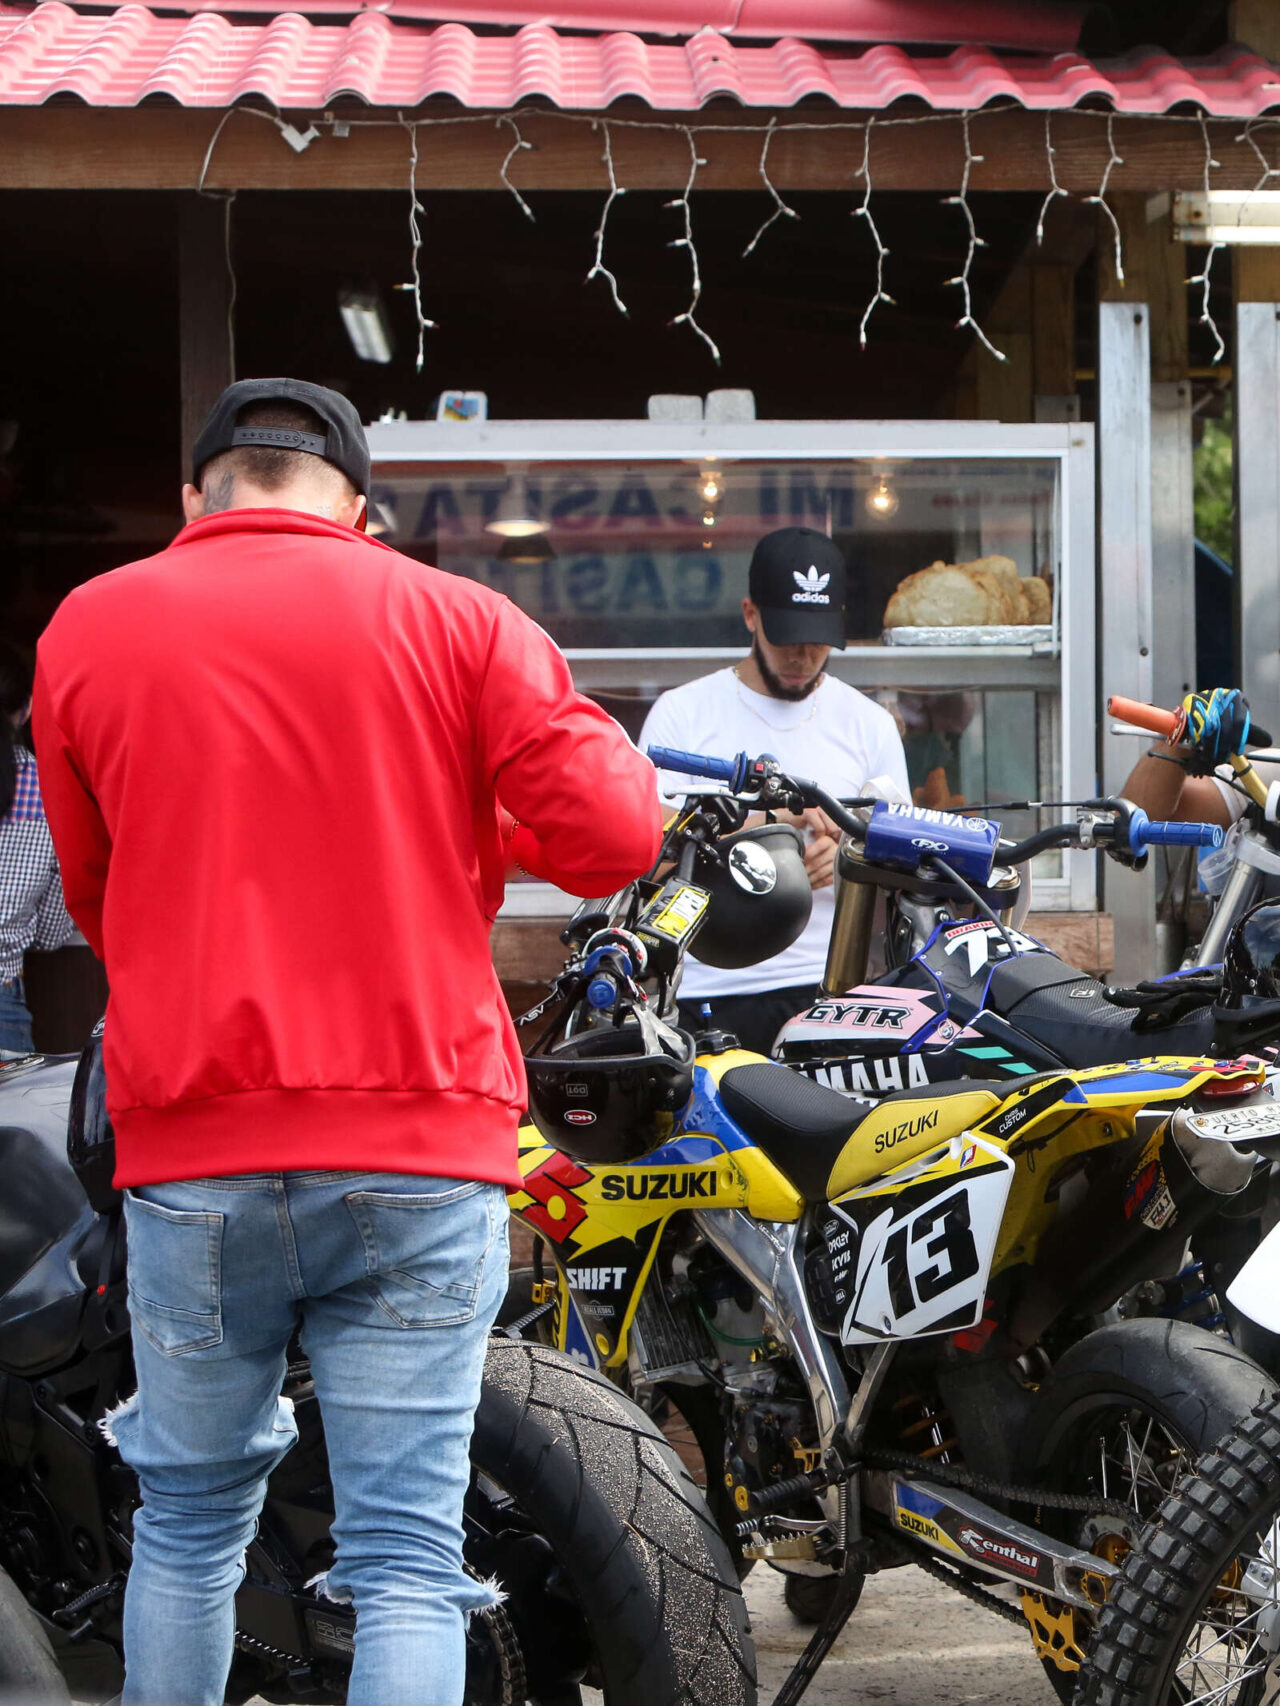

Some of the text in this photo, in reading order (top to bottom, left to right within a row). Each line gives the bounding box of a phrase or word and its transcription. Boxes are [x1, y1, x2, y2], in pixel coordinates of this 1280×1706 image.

[792, 591, 830, 605] adidas
[887, 803, 963, 828] YAMAHA
[801, 1002, 911, 1030] GYTR
[874, 1109, 940, 1154] SUZUKI
[999, 1108, 1027, 1133] CUSTOM
[601, 1170, 717, 1201] SUZUKI
[881, 1187, 980, 1321] 13
[566, 1266, 628, 1290] SHIFT
[900, 1512, 939, 1541] SUZUKI
[957, 1527, 1038, 1568] Renthal
